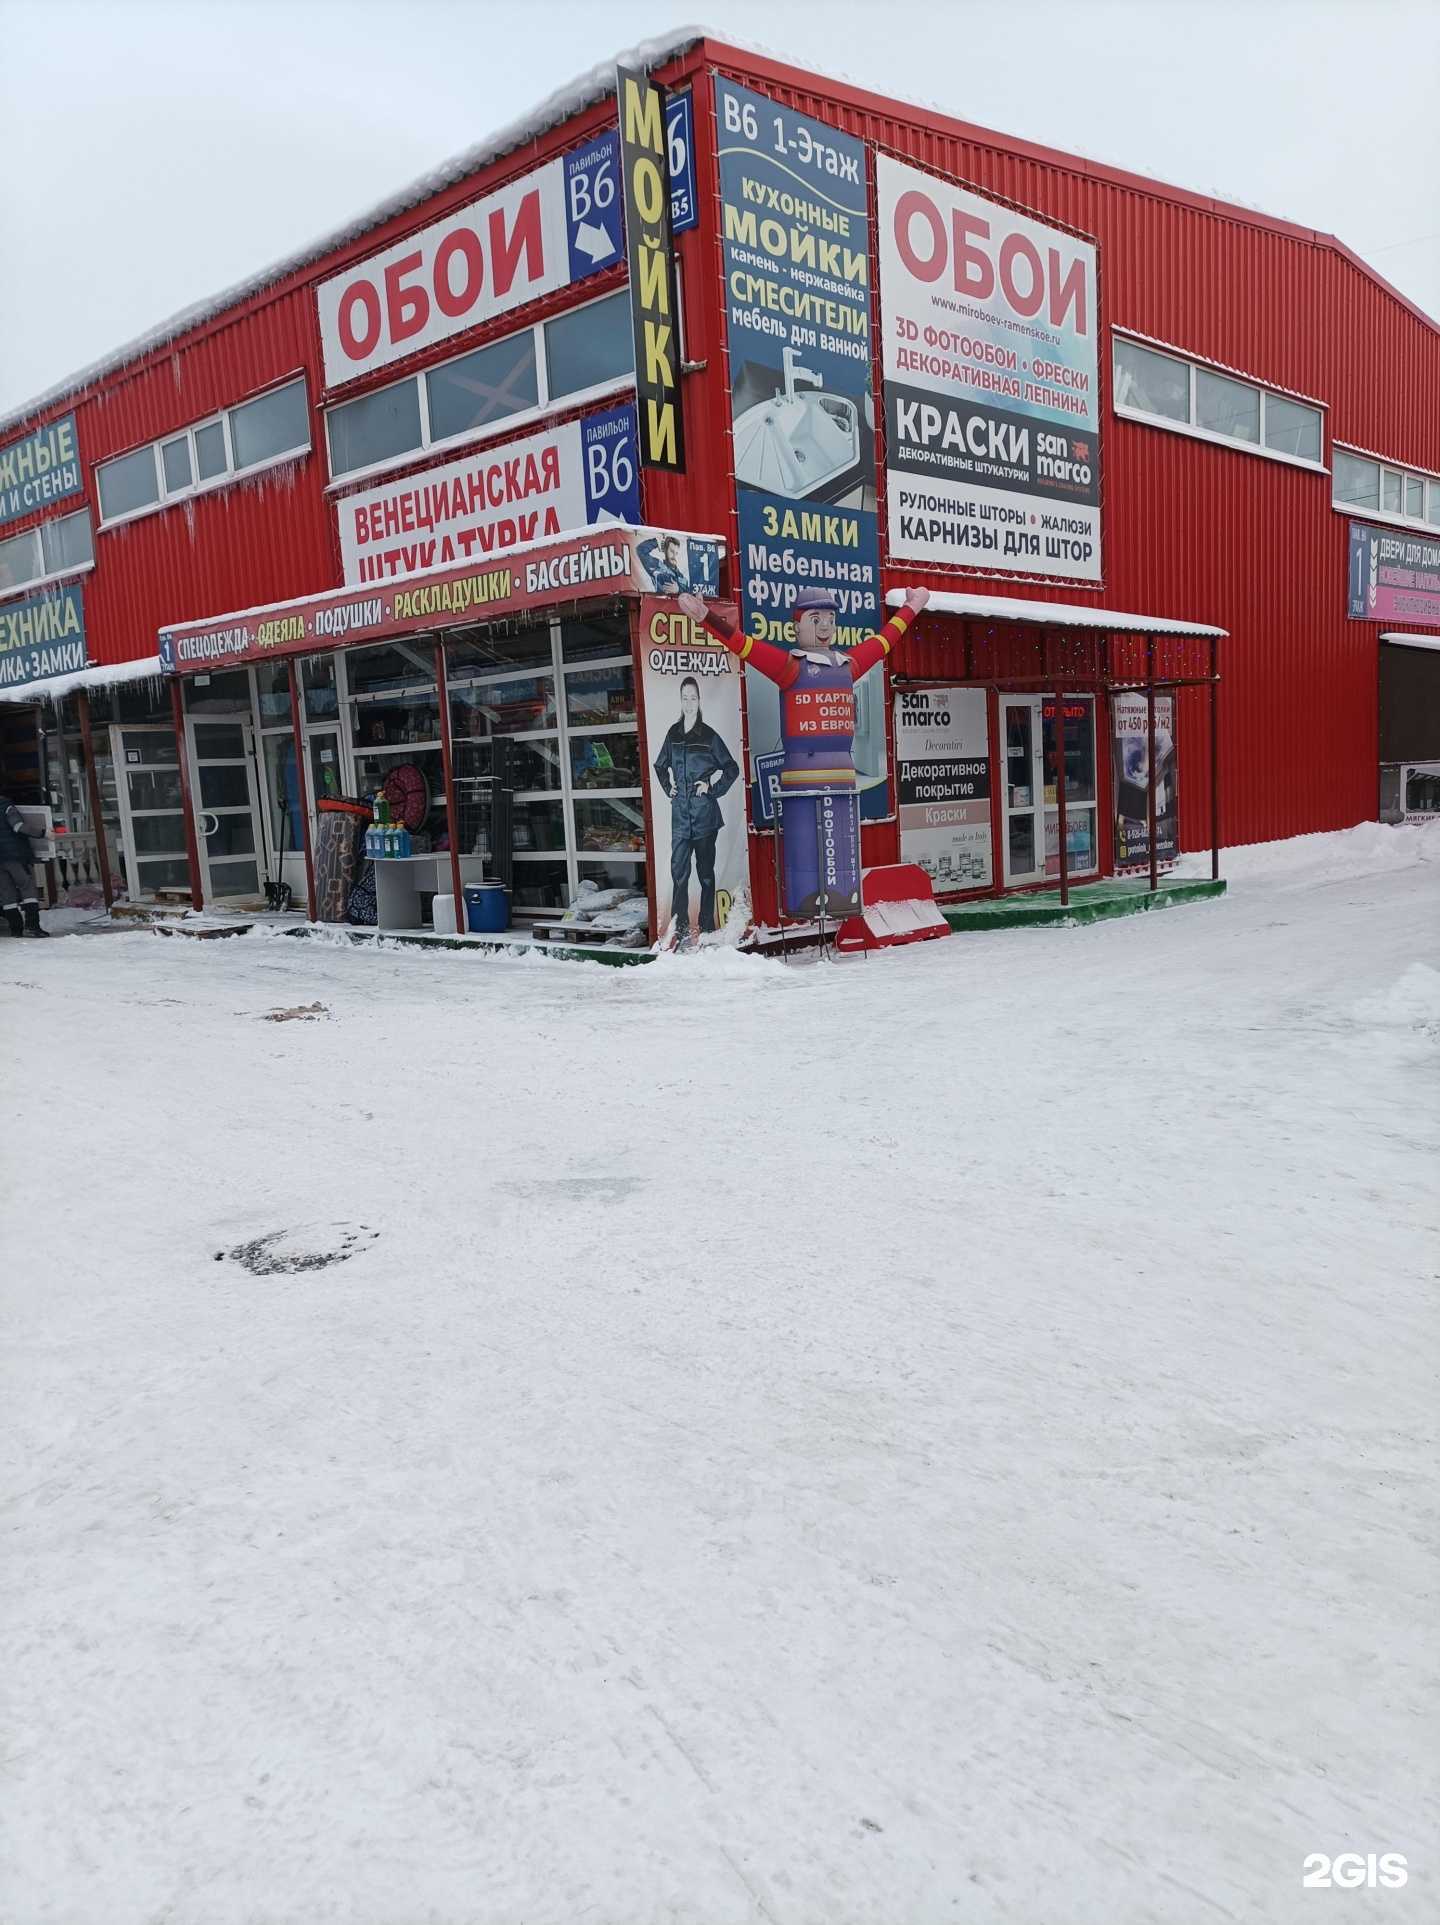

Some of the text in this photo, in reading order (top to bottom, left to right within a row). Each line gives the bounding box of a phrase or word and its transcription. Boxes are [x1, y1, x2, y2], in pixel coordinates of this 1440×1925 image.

[569, 144, 612, 176] ПАВИЛЬОН
[724, 93, 860, 185] В6 1-Этаж
[570, 160, 615, 222] В6
[742, 177, 850, 237] КУХОННЫЕ
[724, 204, 868, 286] МОЙКИ
[894, 190, 1087, 336] ОБОИ
[338, 188, 545, 361] ОБОИ
[625, 78, 677, 464] МОЙКИ
[731, 247, 865, 302] камень нержавейка
[730, 271, 868, 337] СМЕСИТЕЛИ
[931, 295, 1061, 346] www.miroboev-ramenskoe.ru
[733, 307, 868, 361] мебель для ванной
[896, 316, 1089, 392] 3D ФОТООБОИ ФРЕСКИ
[896, 347, 1089, 416] ДЕКОРАТИВНАЯ ЛЕПНИНА
[587, 416, 629, 443] ПАВИЛЬОН
[896, 398, 1030, 466] КРАСКИ
[1036, 432, 1068, 458] san
[588, 436, 634, 500] В6
[898, 446, 1030, 482] ДЕКОРАТИВНЫЕ ШТУКАТУРКИ
[1036, 456, 1091, 485] marco
[10, 489, 20, 513] И
[23, 463, 78, 506] СТЕНЫ
[354, 445, 560, 545] ВЕНЕЦИАНСКАЯ
[762, 506, 858, 547] ЗАМКИ
[899, 491, 1092, 536] РУЛОННЫЕ ШТОРЫ ЖАЛЮЗИ
[900, 516, 1093, 562] КАРНИЗЫ ДЛЯ ШТОР
[1380, 538, 1405, 560] ДВЕРИ
[1406, 543, 1421, 566] ДЛЯ
[700, 553, 710, 581] 1
[748, 544, 873, 583] Мебельная
[1356, 548, 1363, 597] 1
[177, 543, 631, 661] СПЕЦОДЕЖДА ОДЕЯЛА ПОДУШКИ РАСКЛАДУШКИ БАССЕЙНЫ
[692, 583, 717, 595] ЭТАЖ
[32, 641, 84, 677] ЗАМКИ
[650, 649, 731, 676] ОДЕЖДА
[795, 694, 811, 705] 5D
[902, 694, 930, 709] san
[902, 711, 951, 726] marco
[800, 720, 817, 731] ИЗ
[901, 762, 986, 782] Декоративное
[916, 782, 974, 800] покрытие
[925, 807, 967, 825] Краски
[824, 811, 836, 885] ФОТООБОИ
